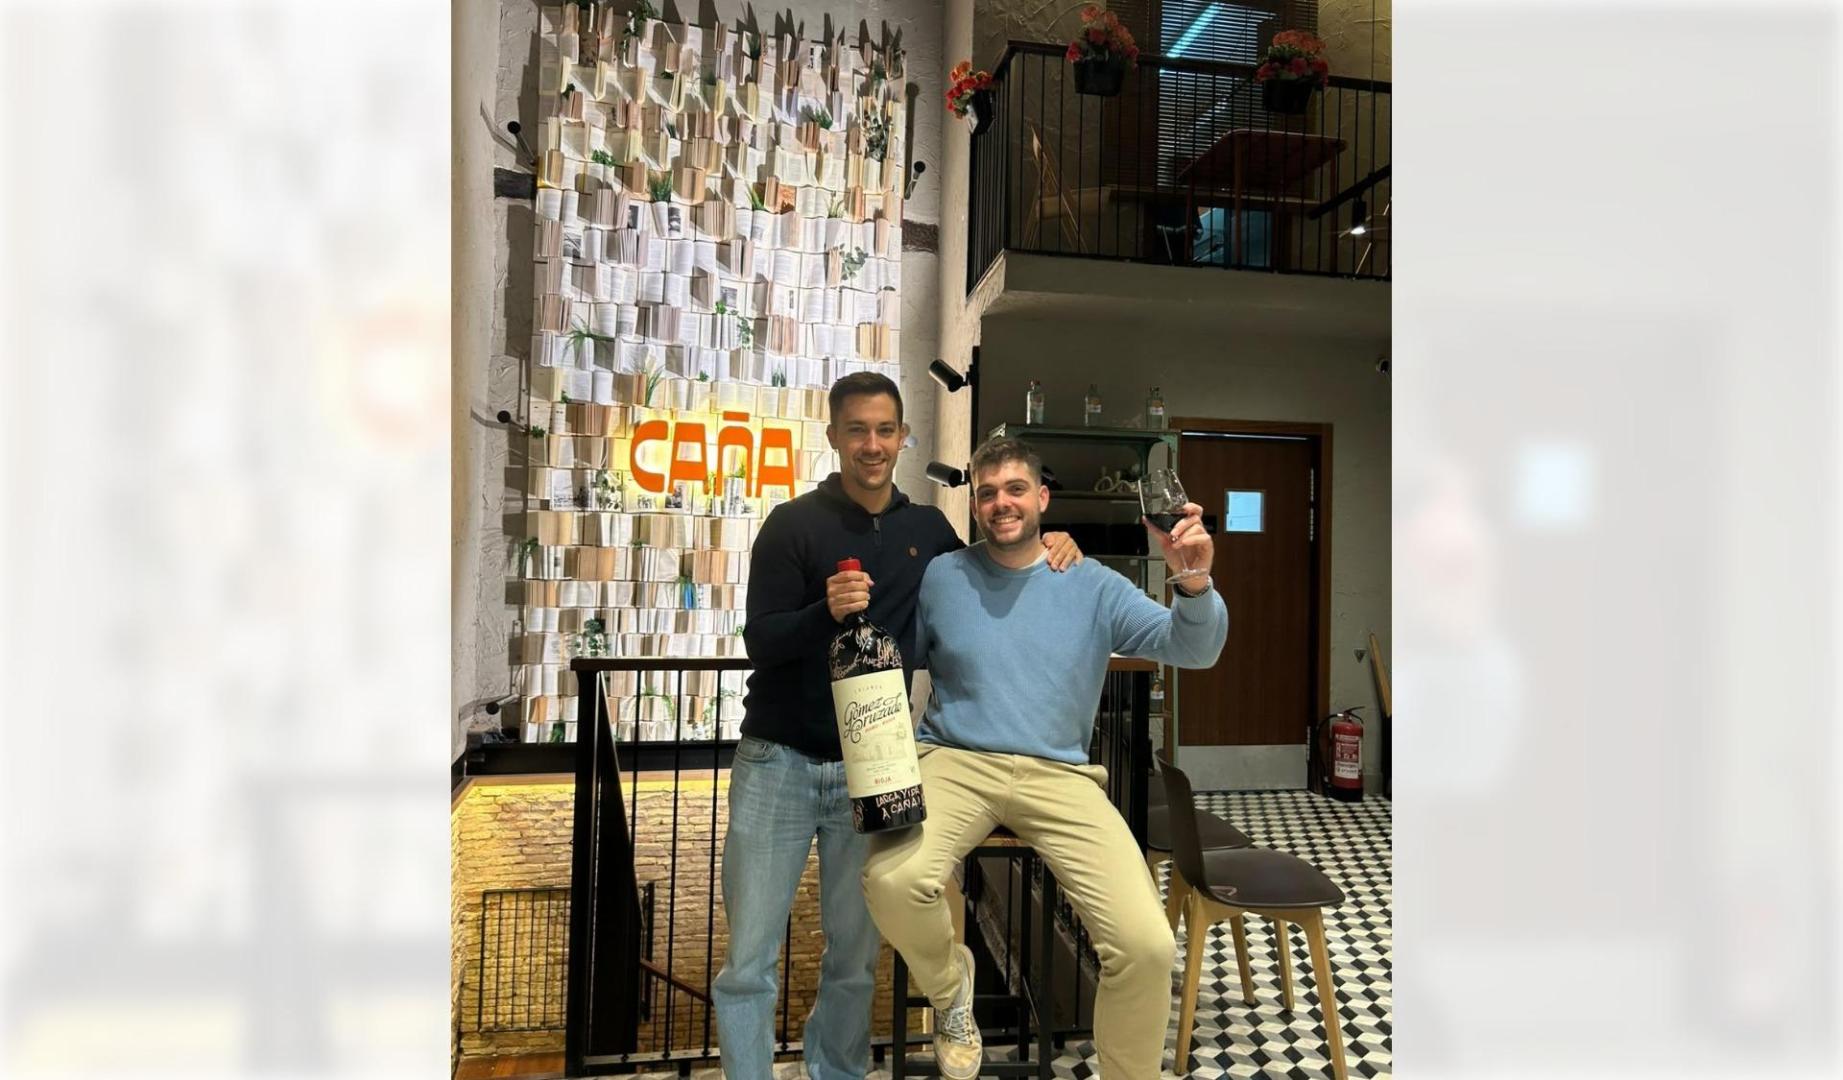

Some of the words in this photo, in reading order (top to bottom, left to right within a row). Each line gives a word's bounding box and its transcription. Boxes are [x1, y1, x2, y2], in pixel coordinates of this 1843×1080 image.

[630, 411, 795, 498] CAÑA
[844, 696, 883, 727] Gómez
[844, 692, 902, 743] Cruzado
[874, 776, 892, 784] RIOJA
